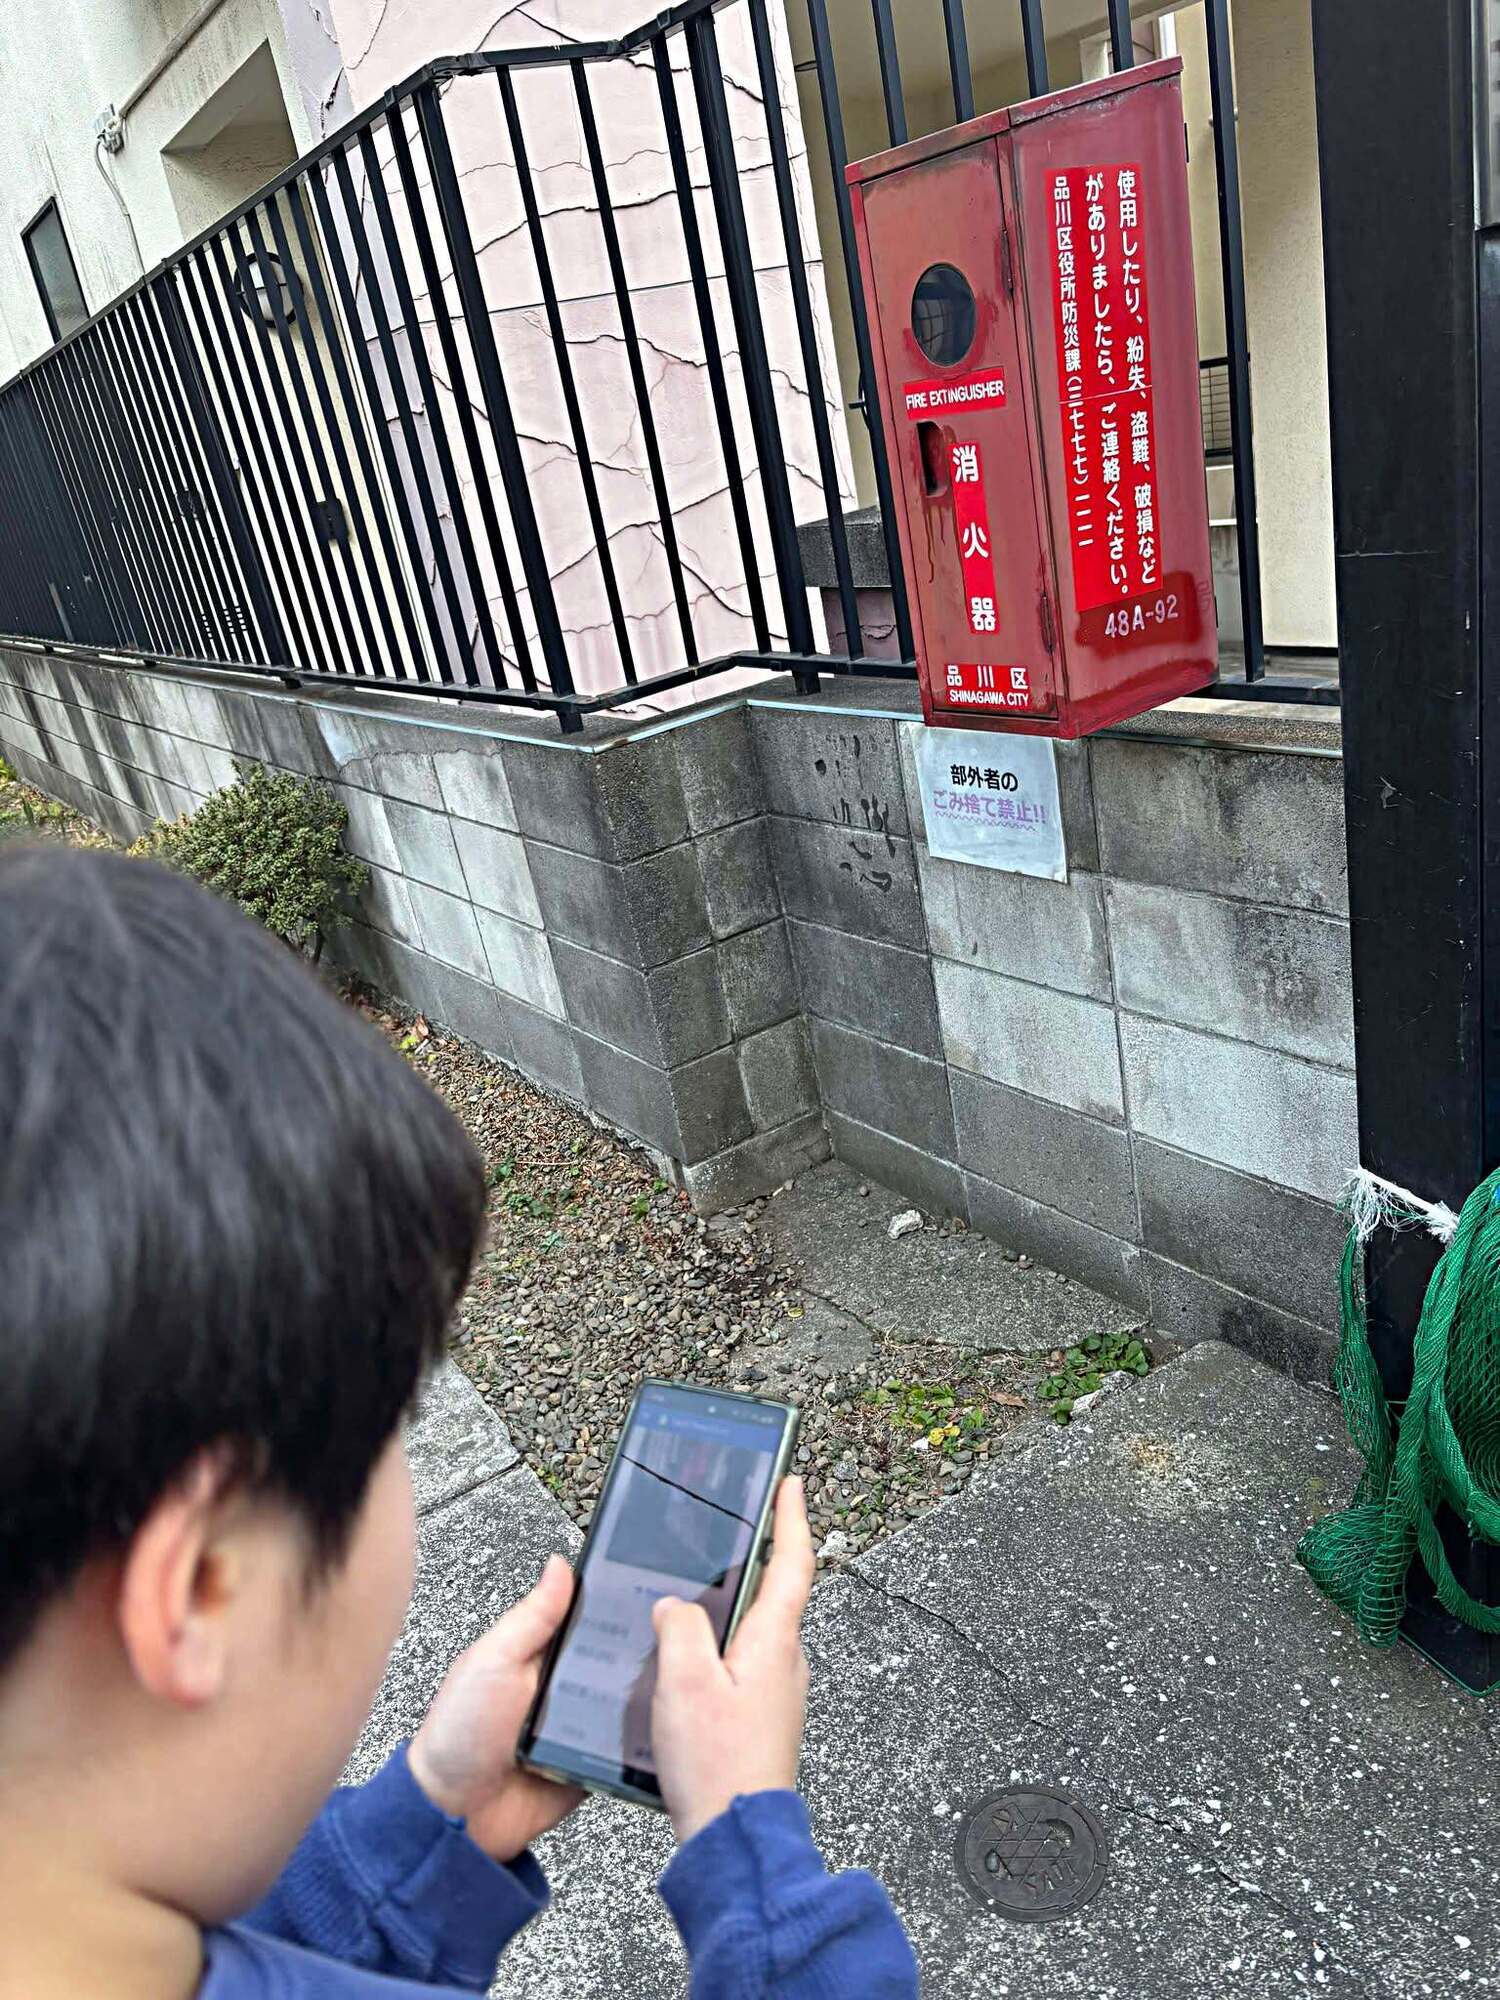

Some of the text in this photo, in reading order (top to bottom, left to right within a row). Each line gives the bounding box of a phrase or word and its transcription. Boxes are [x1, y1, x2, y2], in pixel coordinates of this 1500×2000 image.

[906, 380, 1004, 410] FIRE EXTINGUISHER
[1085, 173, 1128, 594] がありましたら、ご連絡ください。
[1117, 170, 1156, 584] 使用したり、紛失、盗難、破損など
[953, 445, 995, 631] 消火器
[1105, 594, 1178, 638] 48A-92
[947, 665, 1028, 690] 品川区
[949, 688, 1029, 707] SHINAGAWA CITY
[950, 764, 1018, 791] 部外者の
